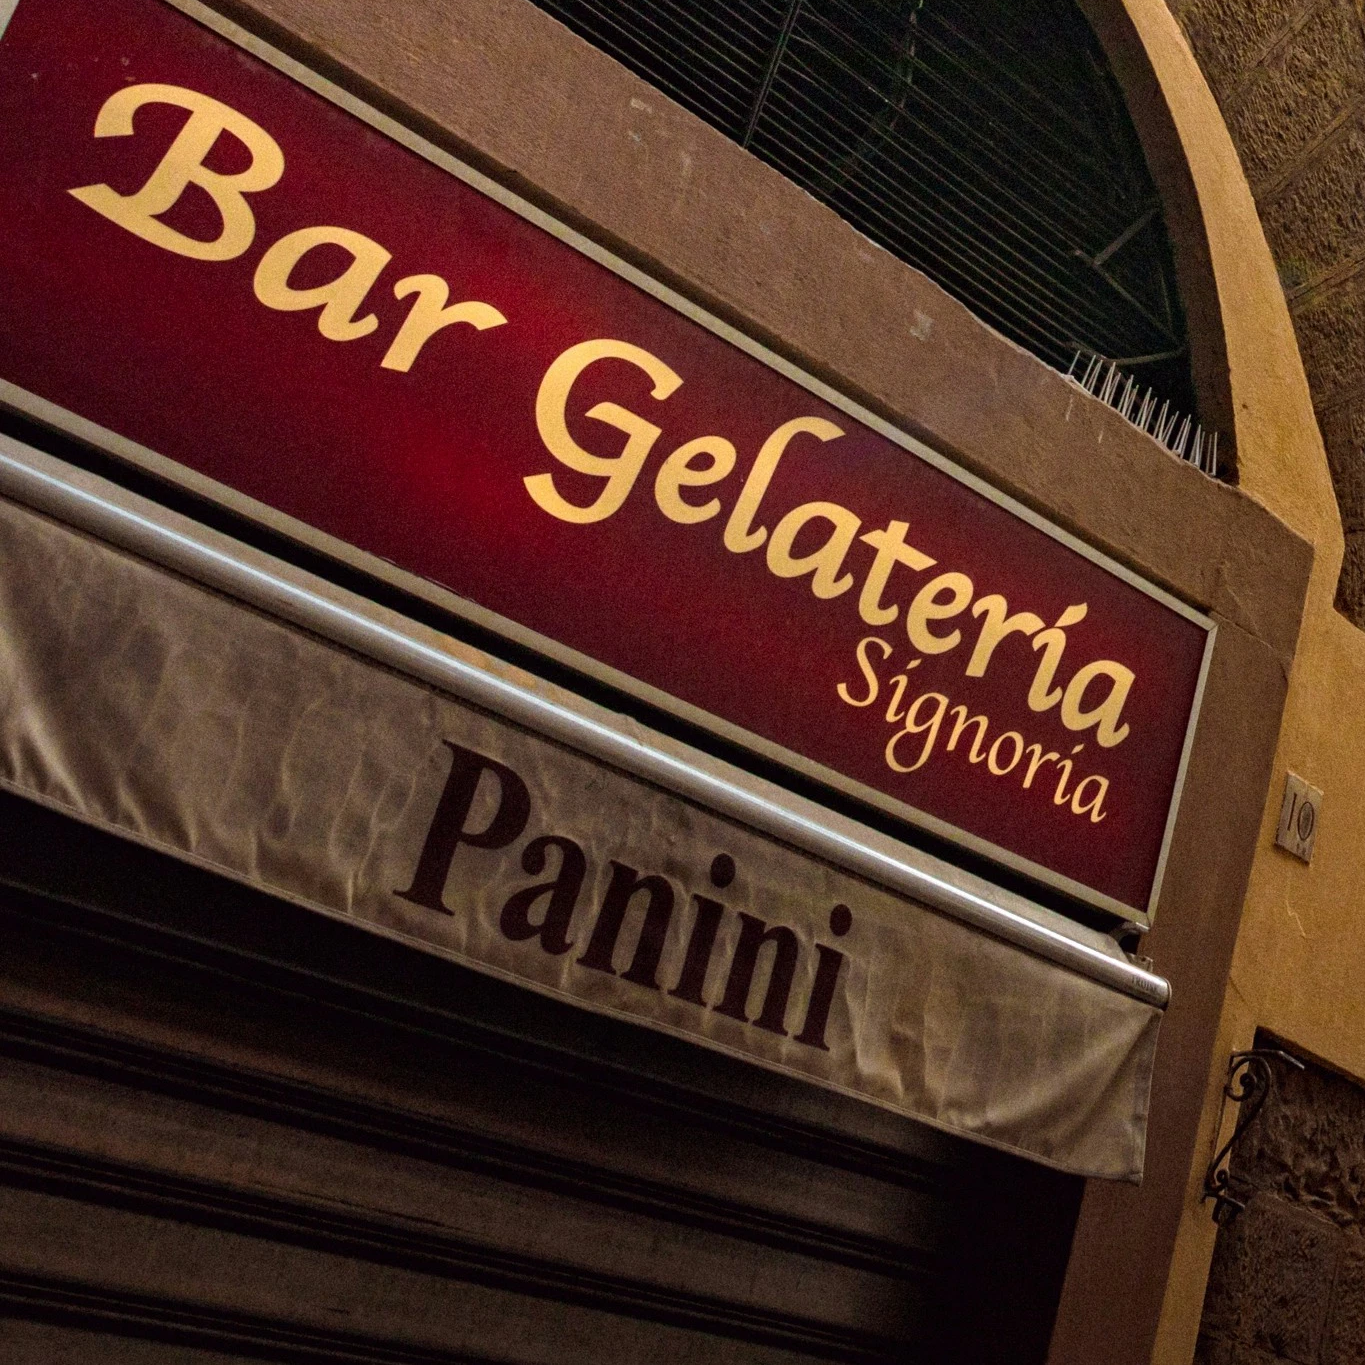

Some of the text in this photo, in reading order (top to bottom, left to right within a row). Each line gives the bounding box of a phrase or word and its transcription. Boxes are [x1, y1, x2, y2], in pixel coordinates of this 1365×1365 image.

[67, 83, 1137, 747] Bar Gelateria
[837, 636, 1109, 823] Signoria
[1287, 792, 1315, 841] 10
[392, 739, 853, 1051] Panini
